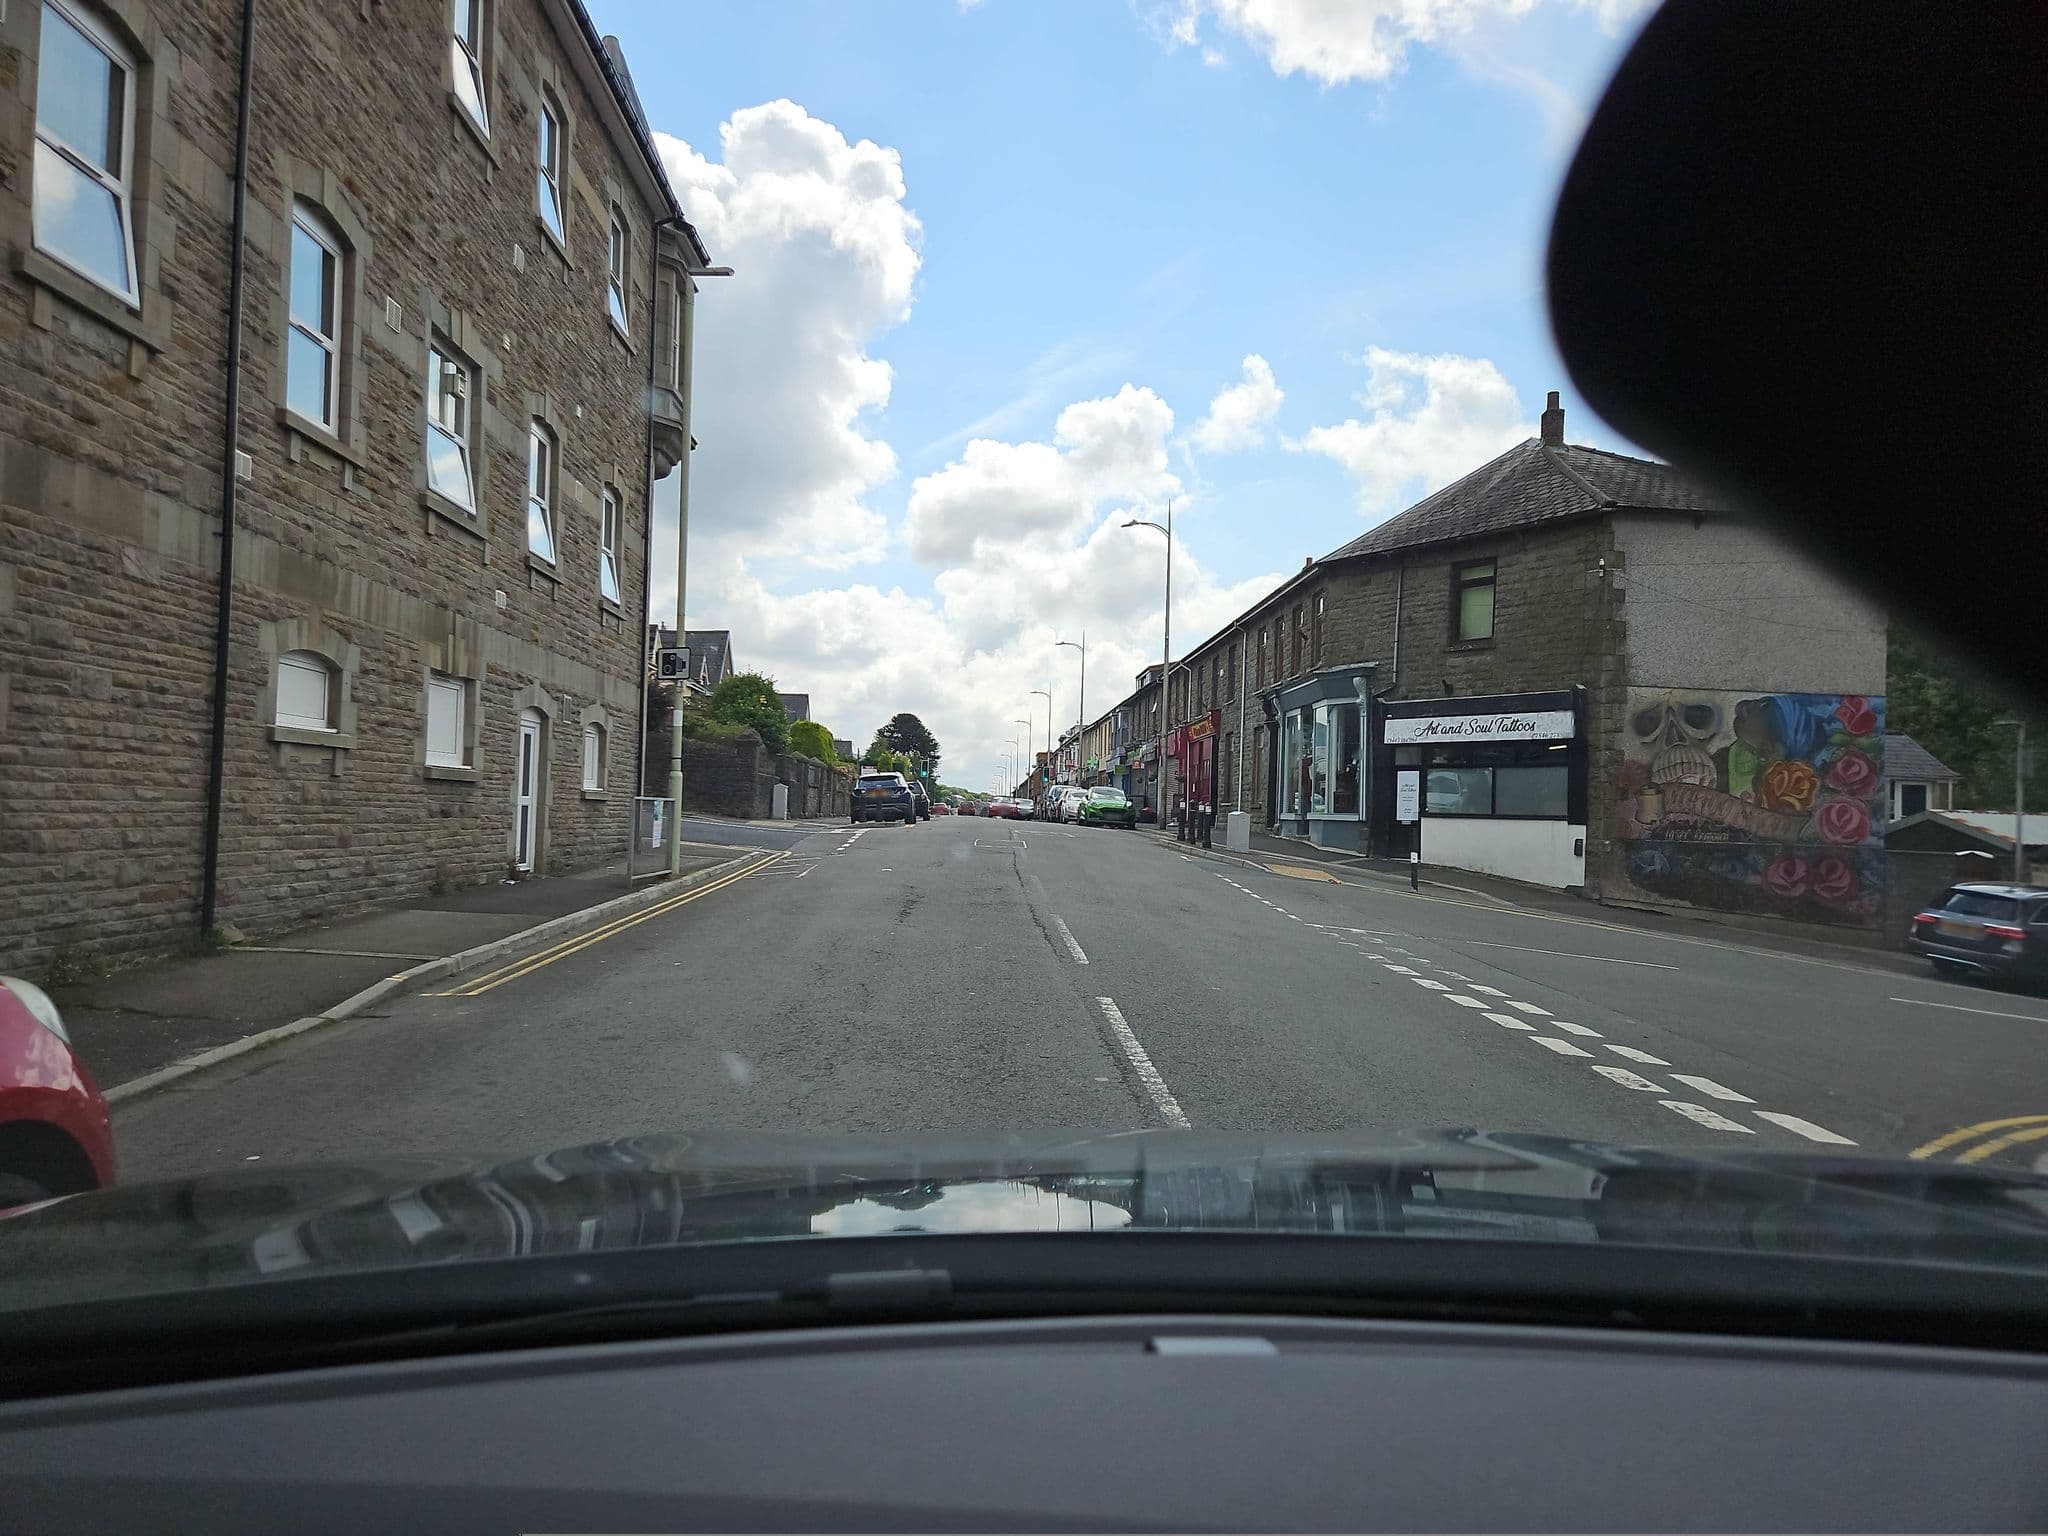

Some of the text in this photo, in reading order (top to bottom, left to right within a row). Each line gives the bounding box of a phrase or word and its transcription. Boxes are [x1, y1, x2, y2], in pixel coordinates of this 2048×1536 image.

[1413, 716, 1537, 737] Art and Soul Tattoos
